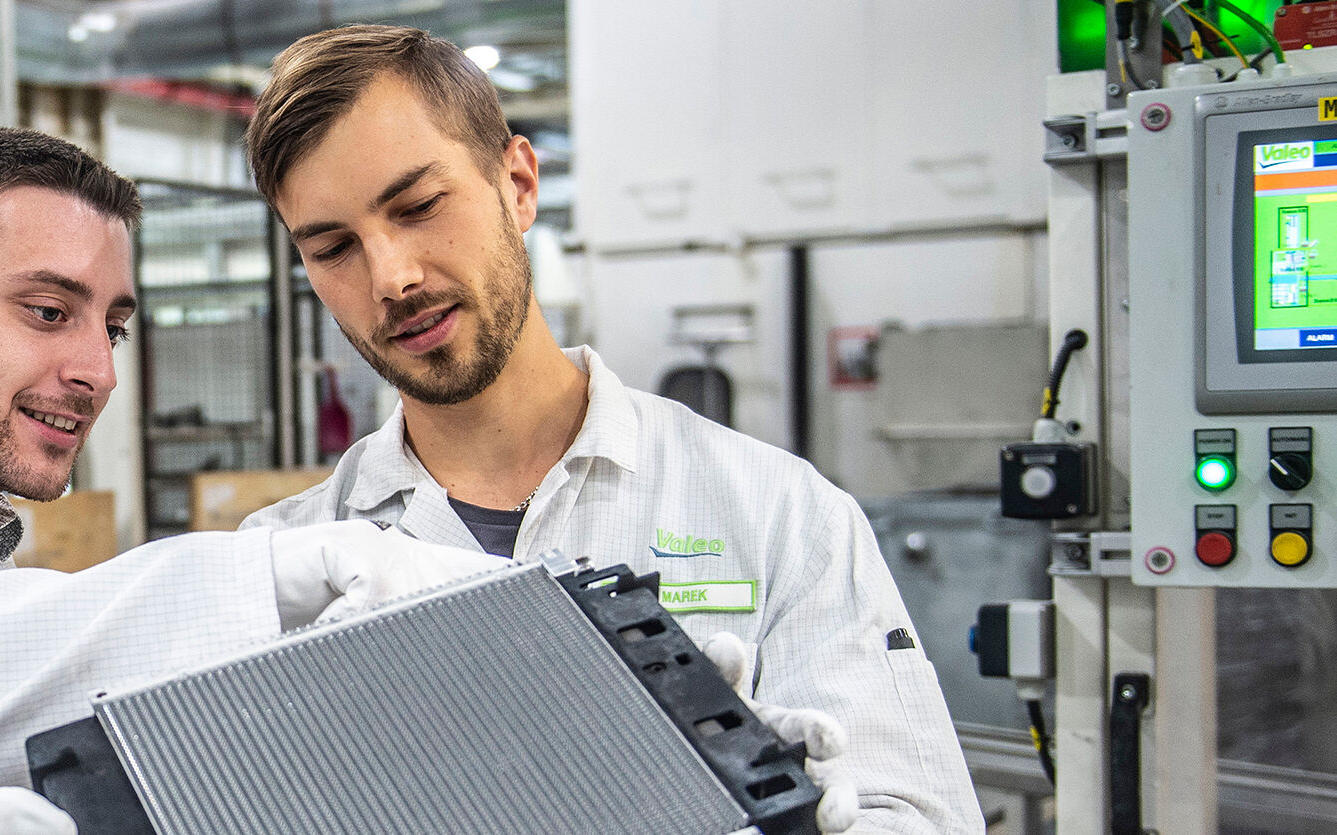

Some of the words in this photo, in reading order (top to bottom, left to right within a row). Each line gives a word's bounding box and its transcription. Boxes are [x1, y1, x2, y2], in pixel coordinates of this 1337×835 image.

[1262, 145, 1311, 161] Valeo
[1306, 334, 1335, 342] ALARM
[656, 528, 725, 553] Valeo
[662, 589, 708, 603] MAREK
